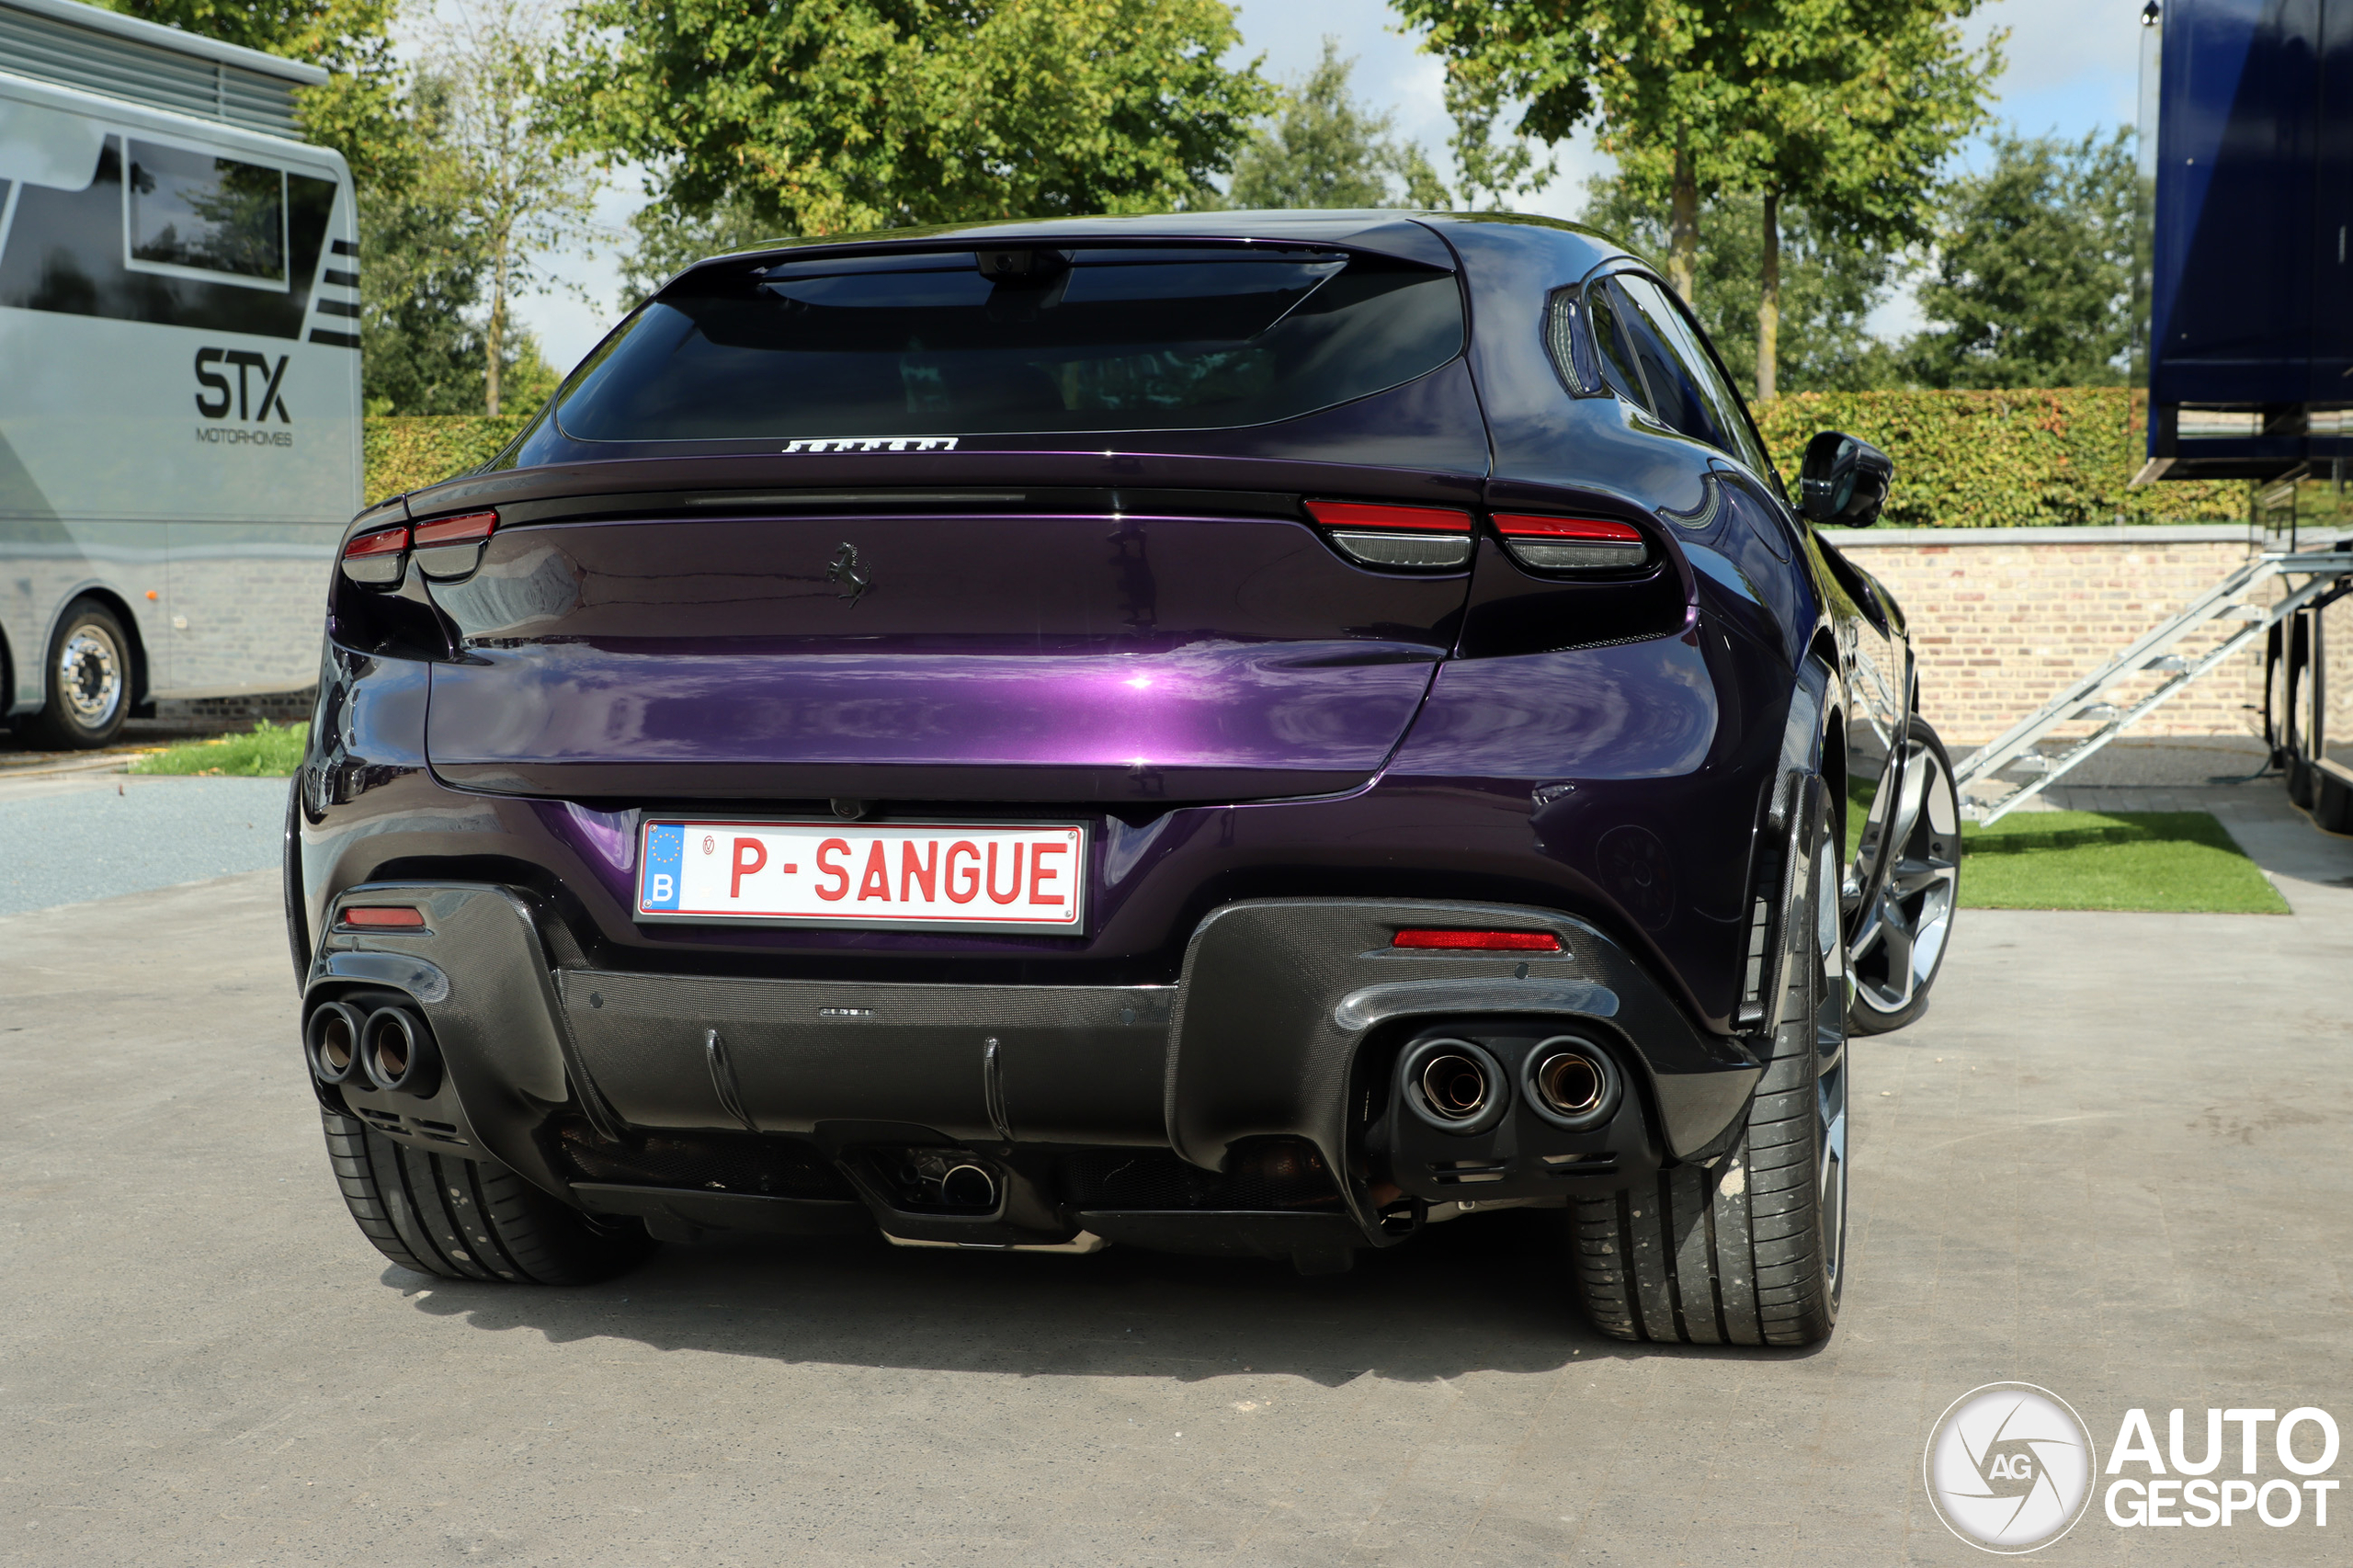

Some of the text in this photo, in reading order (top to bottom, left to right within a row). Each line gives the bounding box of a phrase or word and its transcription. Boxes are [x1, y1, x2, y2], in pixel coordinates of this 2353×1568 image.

[195, 346, 290, 424] STX
[196, 427, 292, 448] MOTORHOMES
[782, 437, 959, 453] Ferrari
[652, 874, 673, 902] B
